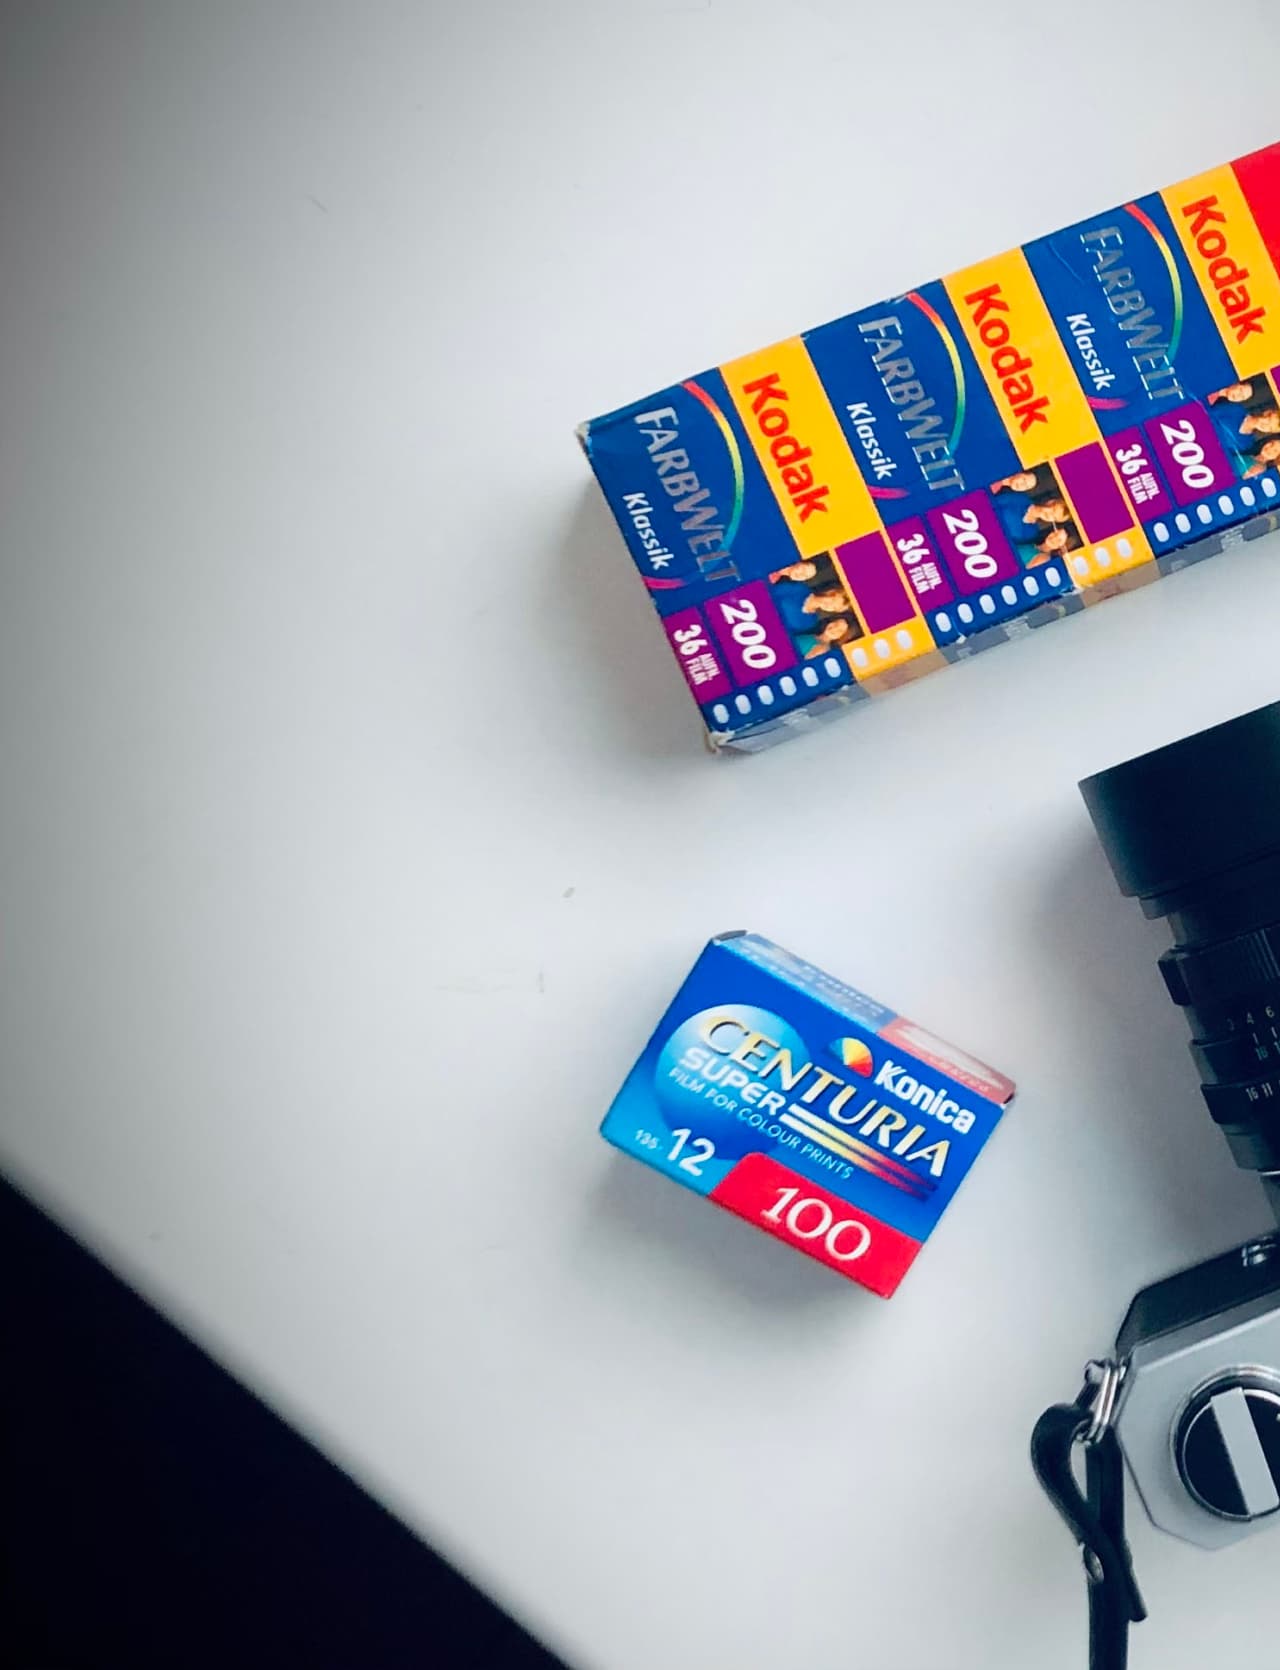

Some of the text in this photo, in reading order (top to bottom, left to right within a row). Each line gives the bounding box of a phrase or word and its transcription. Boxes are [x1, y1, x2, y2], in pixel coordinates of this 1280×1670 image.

[1182, 195, 1266, 344] Kodak
[964, 284, 1050, 434] Kodak
[1066, 313, 1116, 391] Klassik
[743, 372, 829, 524] Kodak
[846, 402, 897, 480] Klassik
[1116, 444, 1147, 475] 36
[1160, 419, 1214, 489] 200
[622, 493, 673, 571] Klassik
[897, 533, 928, 565] 36
[943, 509, 998, 579] 200
[673, 623, 702, 656] 36
[721, 599, 776, 670] 200
[1265, 1006, 1275, 1018] 6
[678, 1047, 787, 1115] SUPER
[702, 1015, 953, 1178] CENTURIA
[874, 1060, 976, 1135] Konica
[1245, 1087, 1259, 1101] 16
[1261, 1082, 1273, 1097] 11
[666, 1127, 716, 1178] 12
[669, 1067, 855, 1181] FILM FOR COLOUR PRINTS
[761, 1186, 872, 1262] 100
